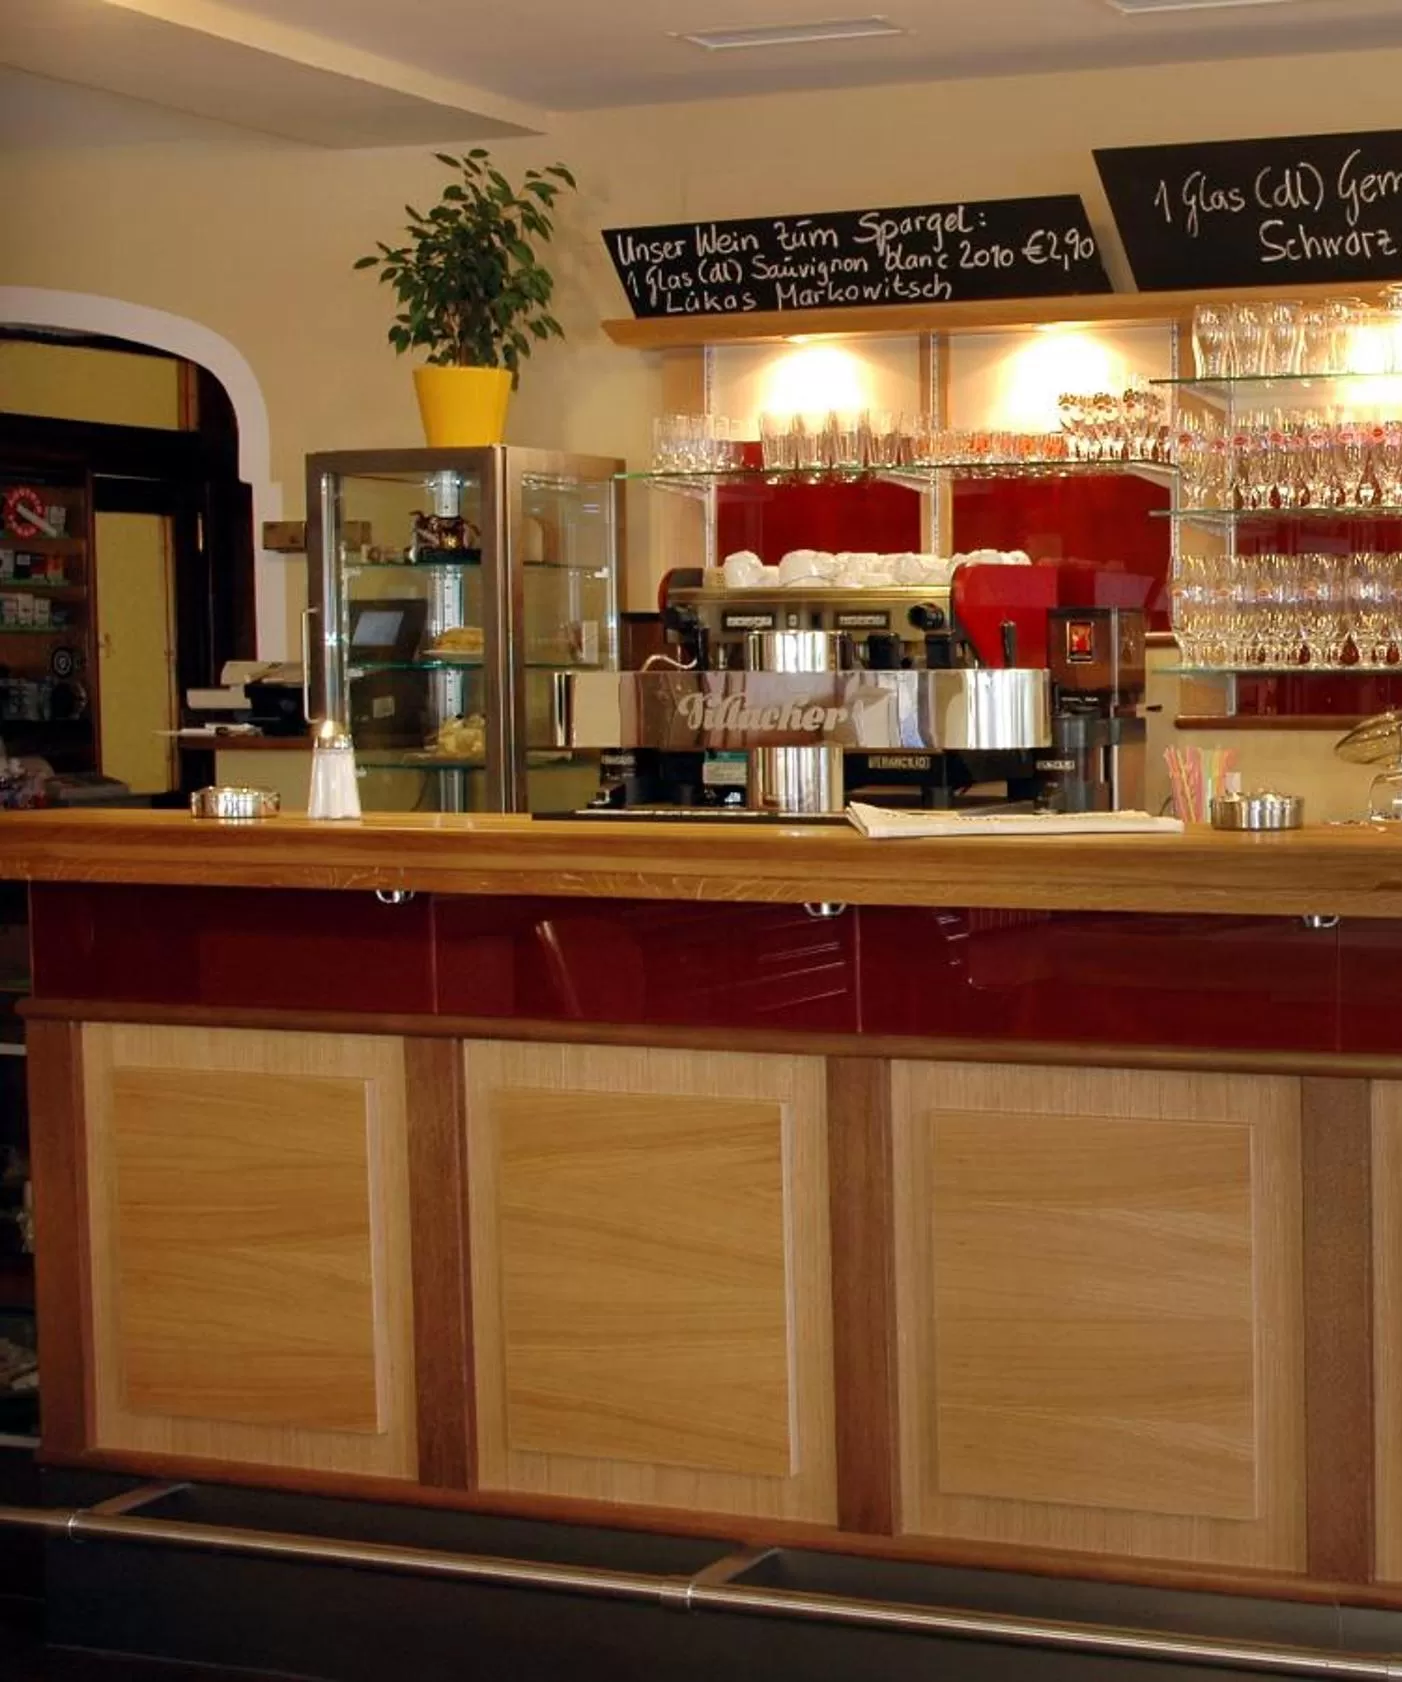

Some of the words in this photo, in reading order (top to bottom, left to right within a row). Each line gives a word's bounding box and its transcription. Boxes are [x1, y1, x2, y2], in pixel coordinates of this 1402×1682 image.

[1154, 179, 1171, 223] 1
[1182, 171, 1245, 238] Glas
[1255, 162, 1324, 213] (dl)
[617, 234, 686, 265] Unser
[696, 224, 759, 257] Wein
[853, 205, 987, 256] Spargel:
[627, 271, 639, 297] 1
[646, 265, 693, 307] Glas
[698, 259, 742, 284] (dl)
[751, 254, 867, 286] Sauvignon
[885, 243, 949, 271] blanc
[960, 240, 1014, 268] 2010
[1022, 228, 1095, 272] €2,90
[666, 290, 757, 313] Lukas
[776, 273, 951, 311] Markowitsch
